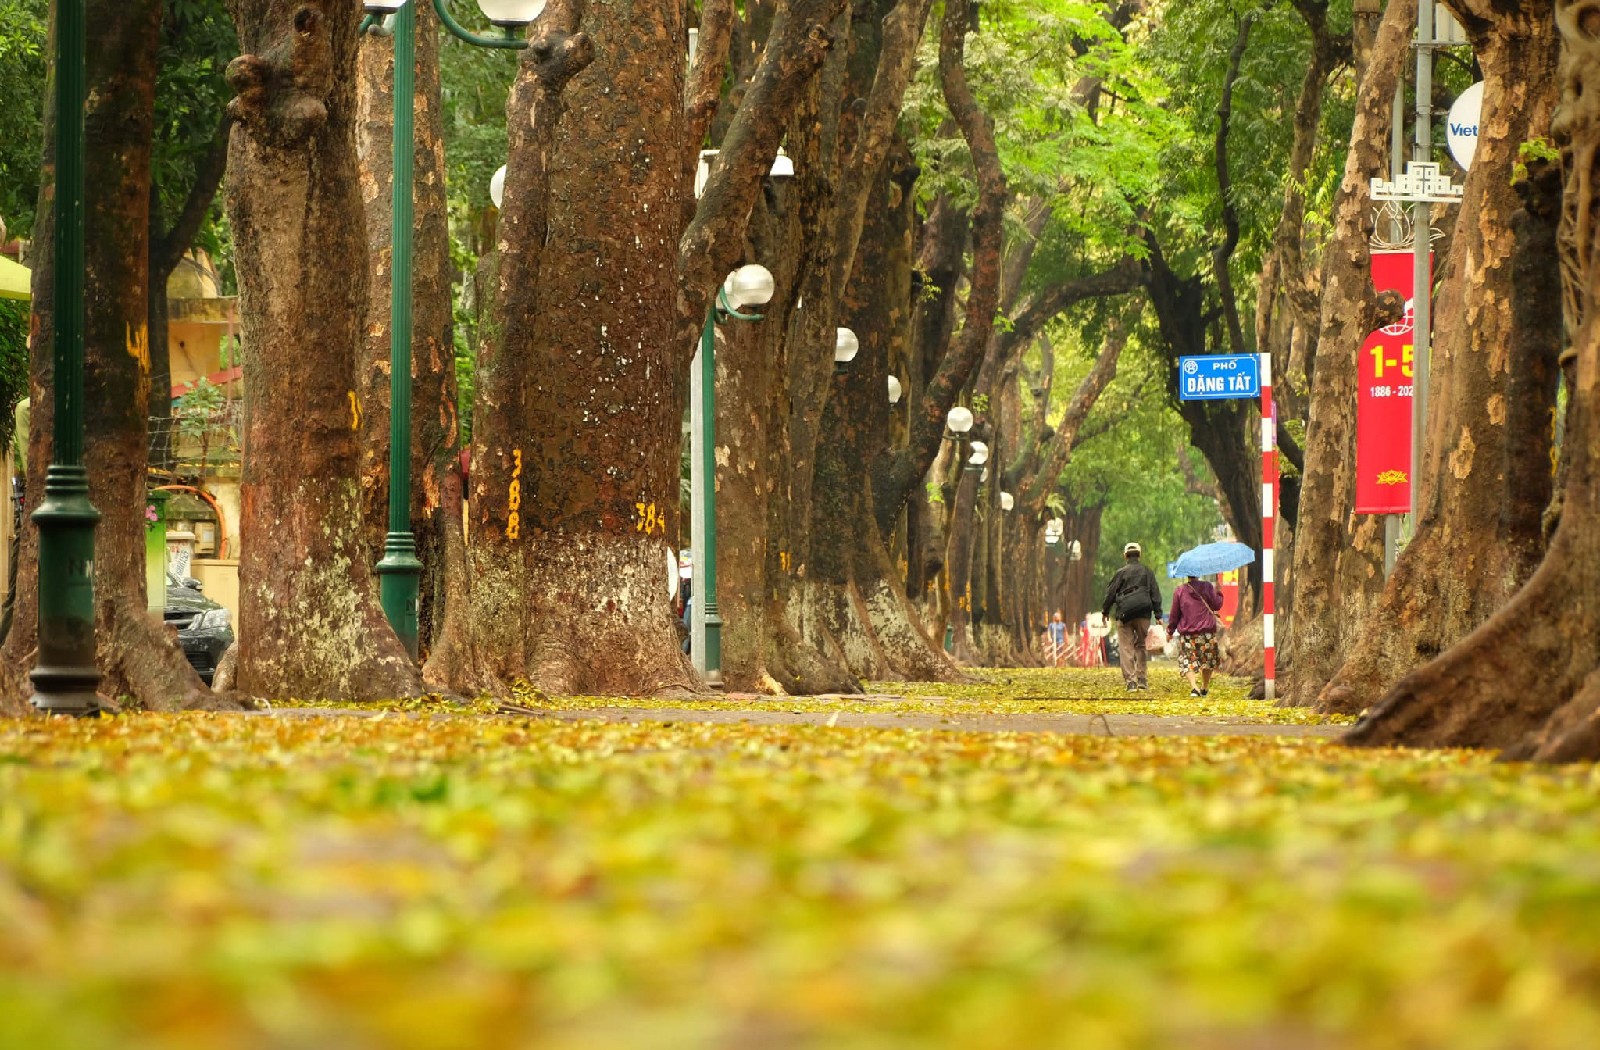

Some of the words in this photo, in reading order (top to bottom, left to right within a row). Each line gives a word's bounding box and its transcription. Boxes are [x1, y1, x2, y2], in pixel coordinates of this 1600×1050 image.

[1213, 359, 1237, 370] PHỐ
[1228, 372, 1251, 391] TẤT
[1370, 385, 1391, 397] 1886
[1397, 385, 1414, 397] 202
